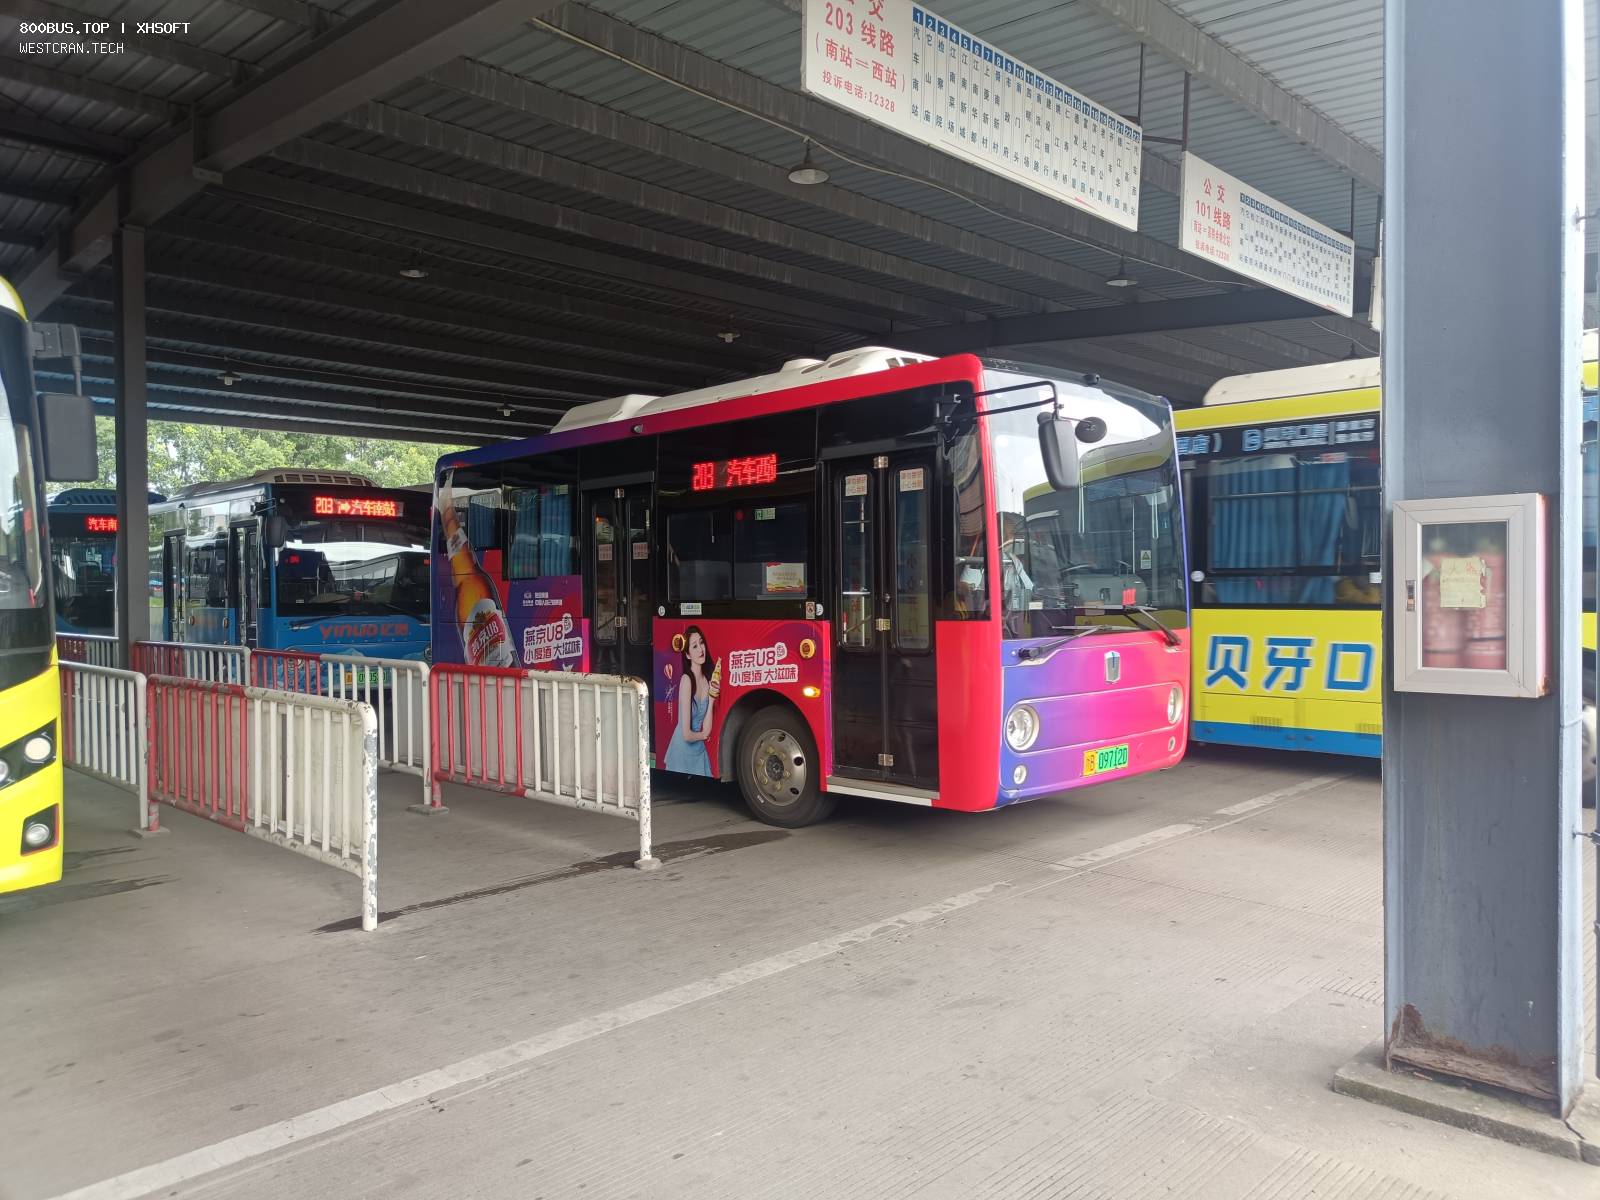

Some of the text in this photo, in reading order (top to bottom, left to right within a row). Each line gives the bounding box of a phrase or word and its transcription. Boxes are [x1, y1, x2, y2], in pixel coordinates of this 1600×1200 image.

[912, 27, 920, 116] 汽车南站
[1203, 178, 1226, 204] 公交
[315, 496, 396, 517] 203 汽车南站
[525, 624, 563, 647] 燕京U8
[731, 650, 776, 670] 燕京U8
[1205, 635, 1374, 691] 贝牙口
